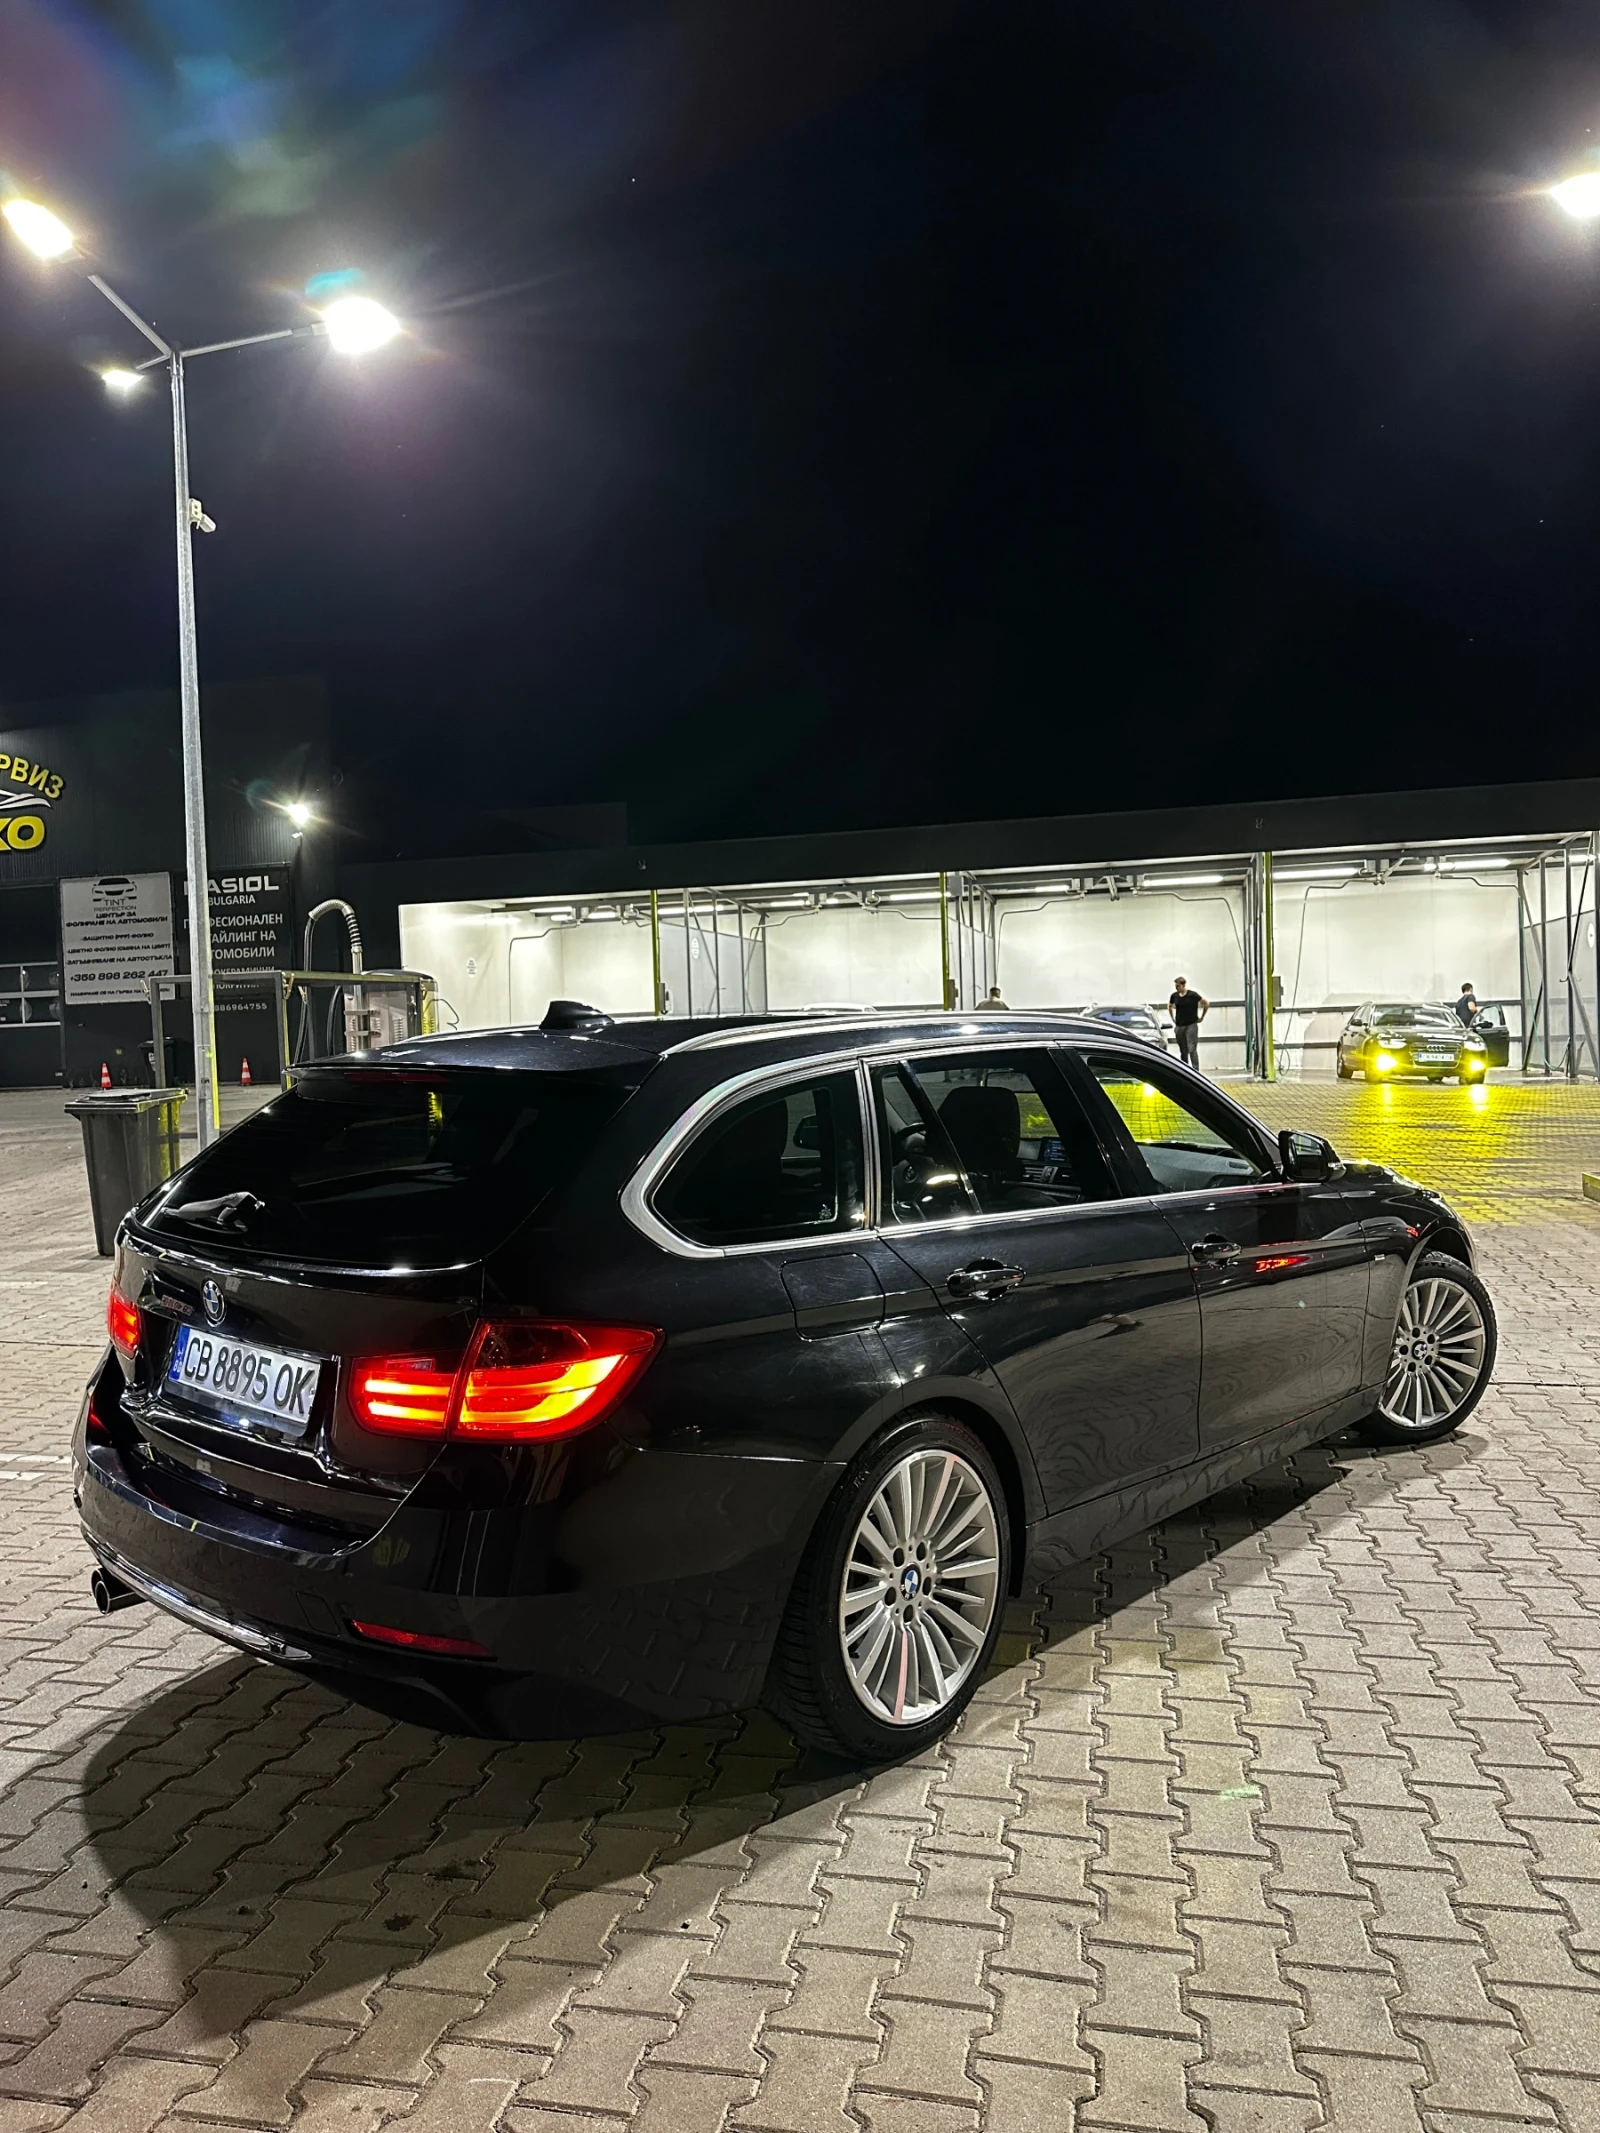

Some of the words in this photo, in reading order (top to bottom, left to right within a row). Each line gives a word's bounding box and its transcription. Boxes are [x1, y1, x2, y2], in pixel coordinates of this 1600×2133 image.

[184, 875, 280, 895] ASIOL
[208, 894, 256, 906] BULGARIA
[184, 913, 283, 929] ПФЕСИОНАЛЕН
[210, 930, 257, 944] АЙЛИНГ
[260, 930, 277, 941] НА
[210, 946, 275, 960] ОМОБИЛИ
[70, 972, 96, 982] +359
[98, 972, 121, 981] 898
[122, 970, 146, 979] 262
[148, 969, 169, 977] 447
[184, 1337, 213, 1382] CB
[212, 1346, 272, 1403] 8895
[273, 1363, 316, 1415] OK
